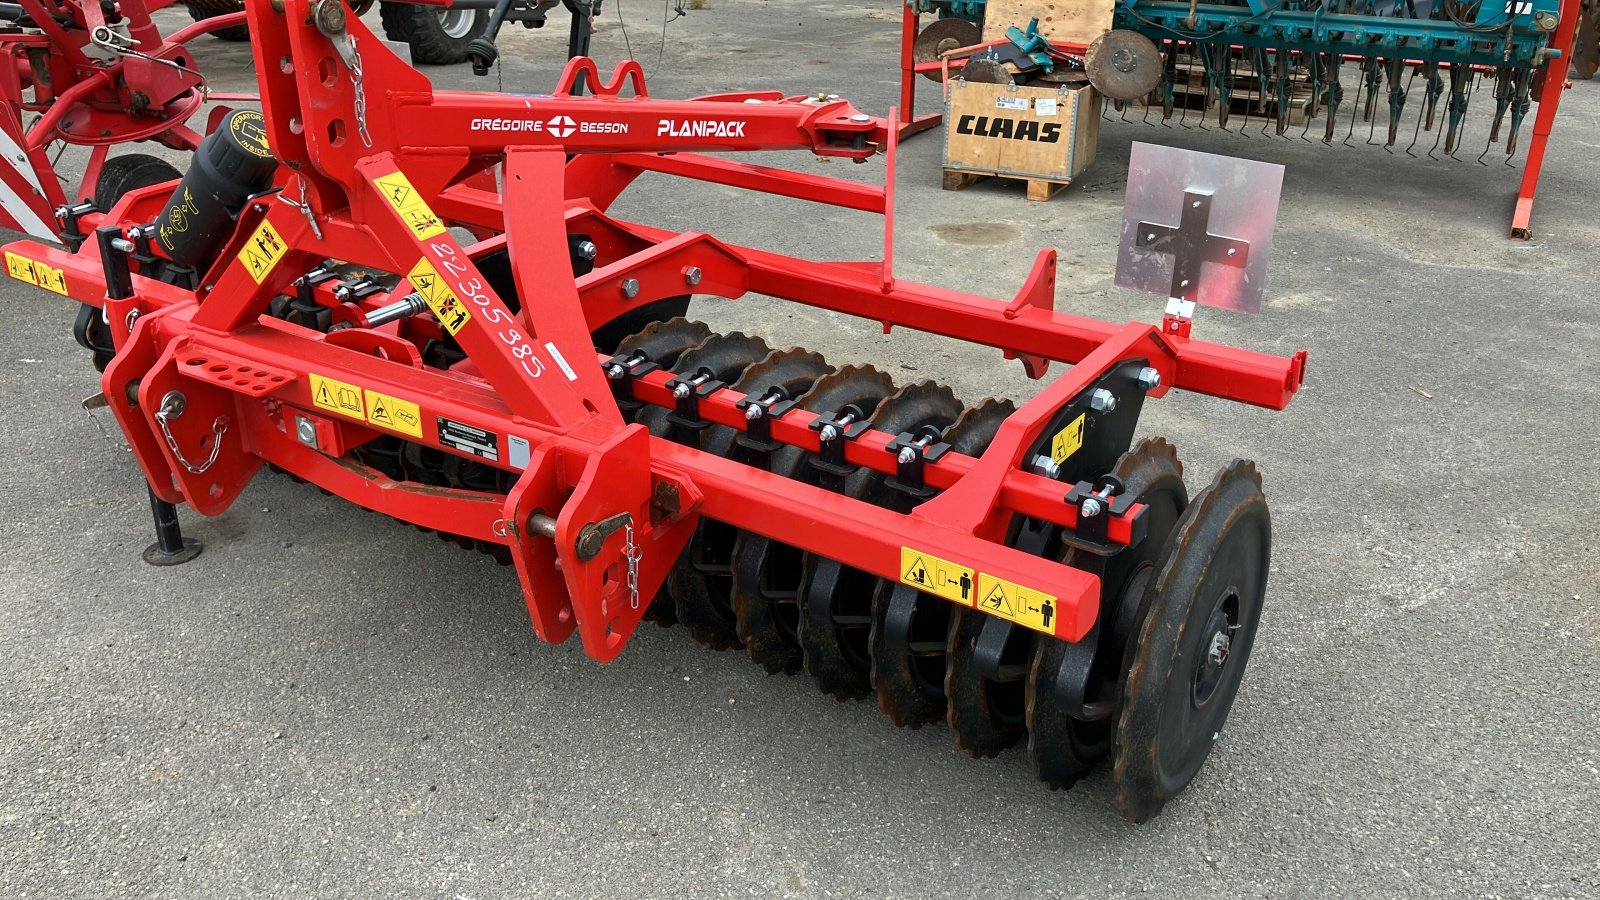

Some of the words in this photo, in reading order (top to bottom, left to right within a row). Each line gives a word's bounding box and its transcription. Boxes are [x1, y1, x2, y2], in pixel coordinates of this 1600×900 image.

[470, 118, 544, 132] GRÉGOIRE
[580, 122, 629, 134] BESSON
[657, 119, 747, 138] PLANIPACK
[956, 114, 1063, 144] CLAAS
[241, 139, 269, 156] INSIDE
